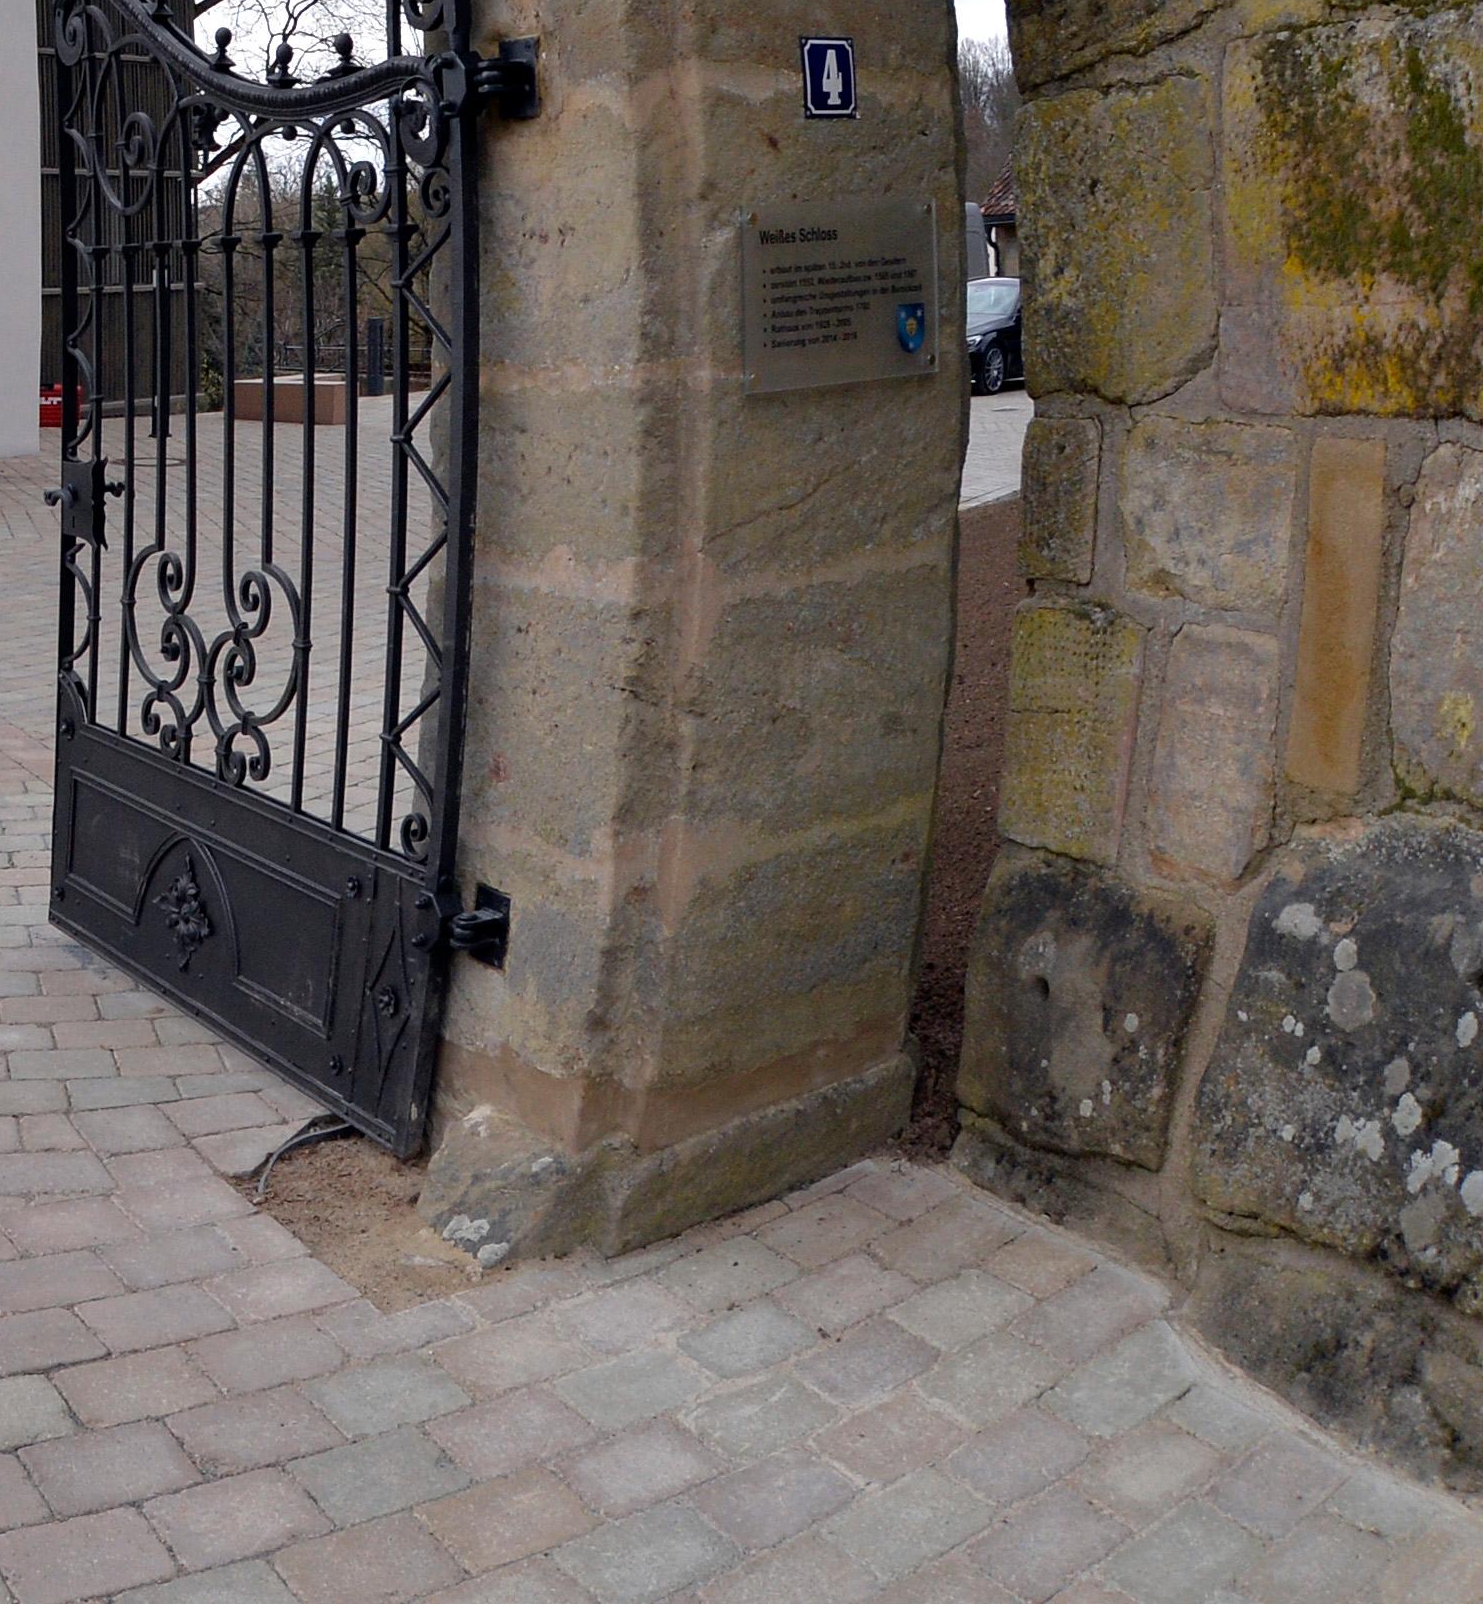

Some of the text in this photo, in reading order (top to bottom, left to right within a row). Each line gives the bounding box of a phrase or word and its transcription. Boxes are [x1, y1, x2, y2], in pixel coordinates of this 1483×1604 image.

[822, 49, 843, 105] 4
[759, 227, 838, 245] Weißes Schloss
